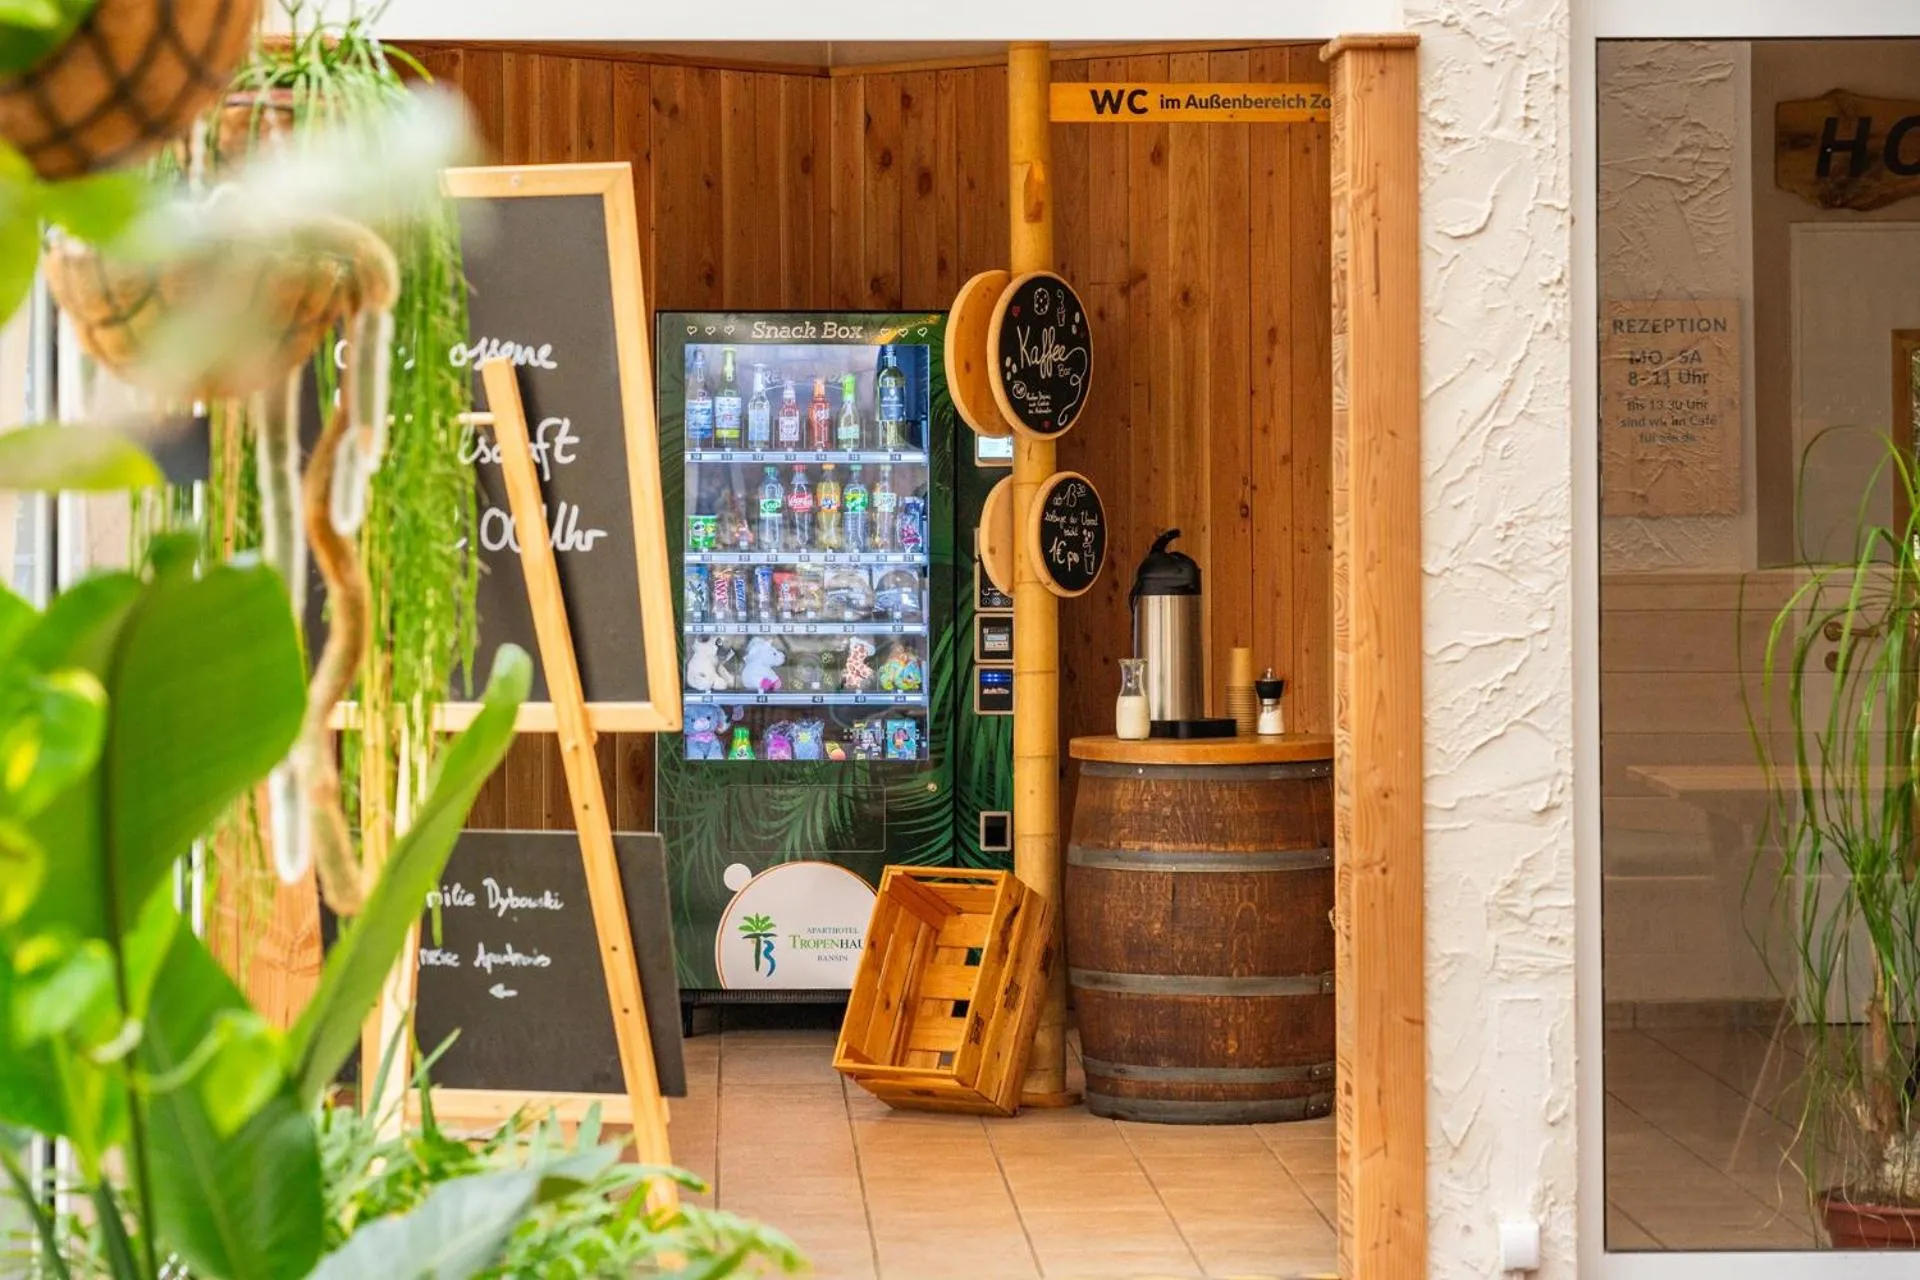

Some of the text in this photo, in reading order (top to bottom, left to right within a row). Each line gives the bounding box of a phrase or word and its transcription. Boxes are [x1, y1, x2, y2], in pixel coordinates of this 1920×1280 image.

[1090, 89, 1148, 115] WC
[1160, 94, 1180, 109] im
[1185, 93, 1306, 109] Außenbereich
[751, 321, 864, 339] Snack Box
[1613, 317, 1727, 334] REZEPTION
[1016, 325, 1067, 380] Kaffee
[1678, 368, 1709, 385] Uhr
[806, 926, 859, 935] APARTHOTEL
[789, 933, 864, 950] TROPENHAU
[817, 954, 848, 963] BANSIN
